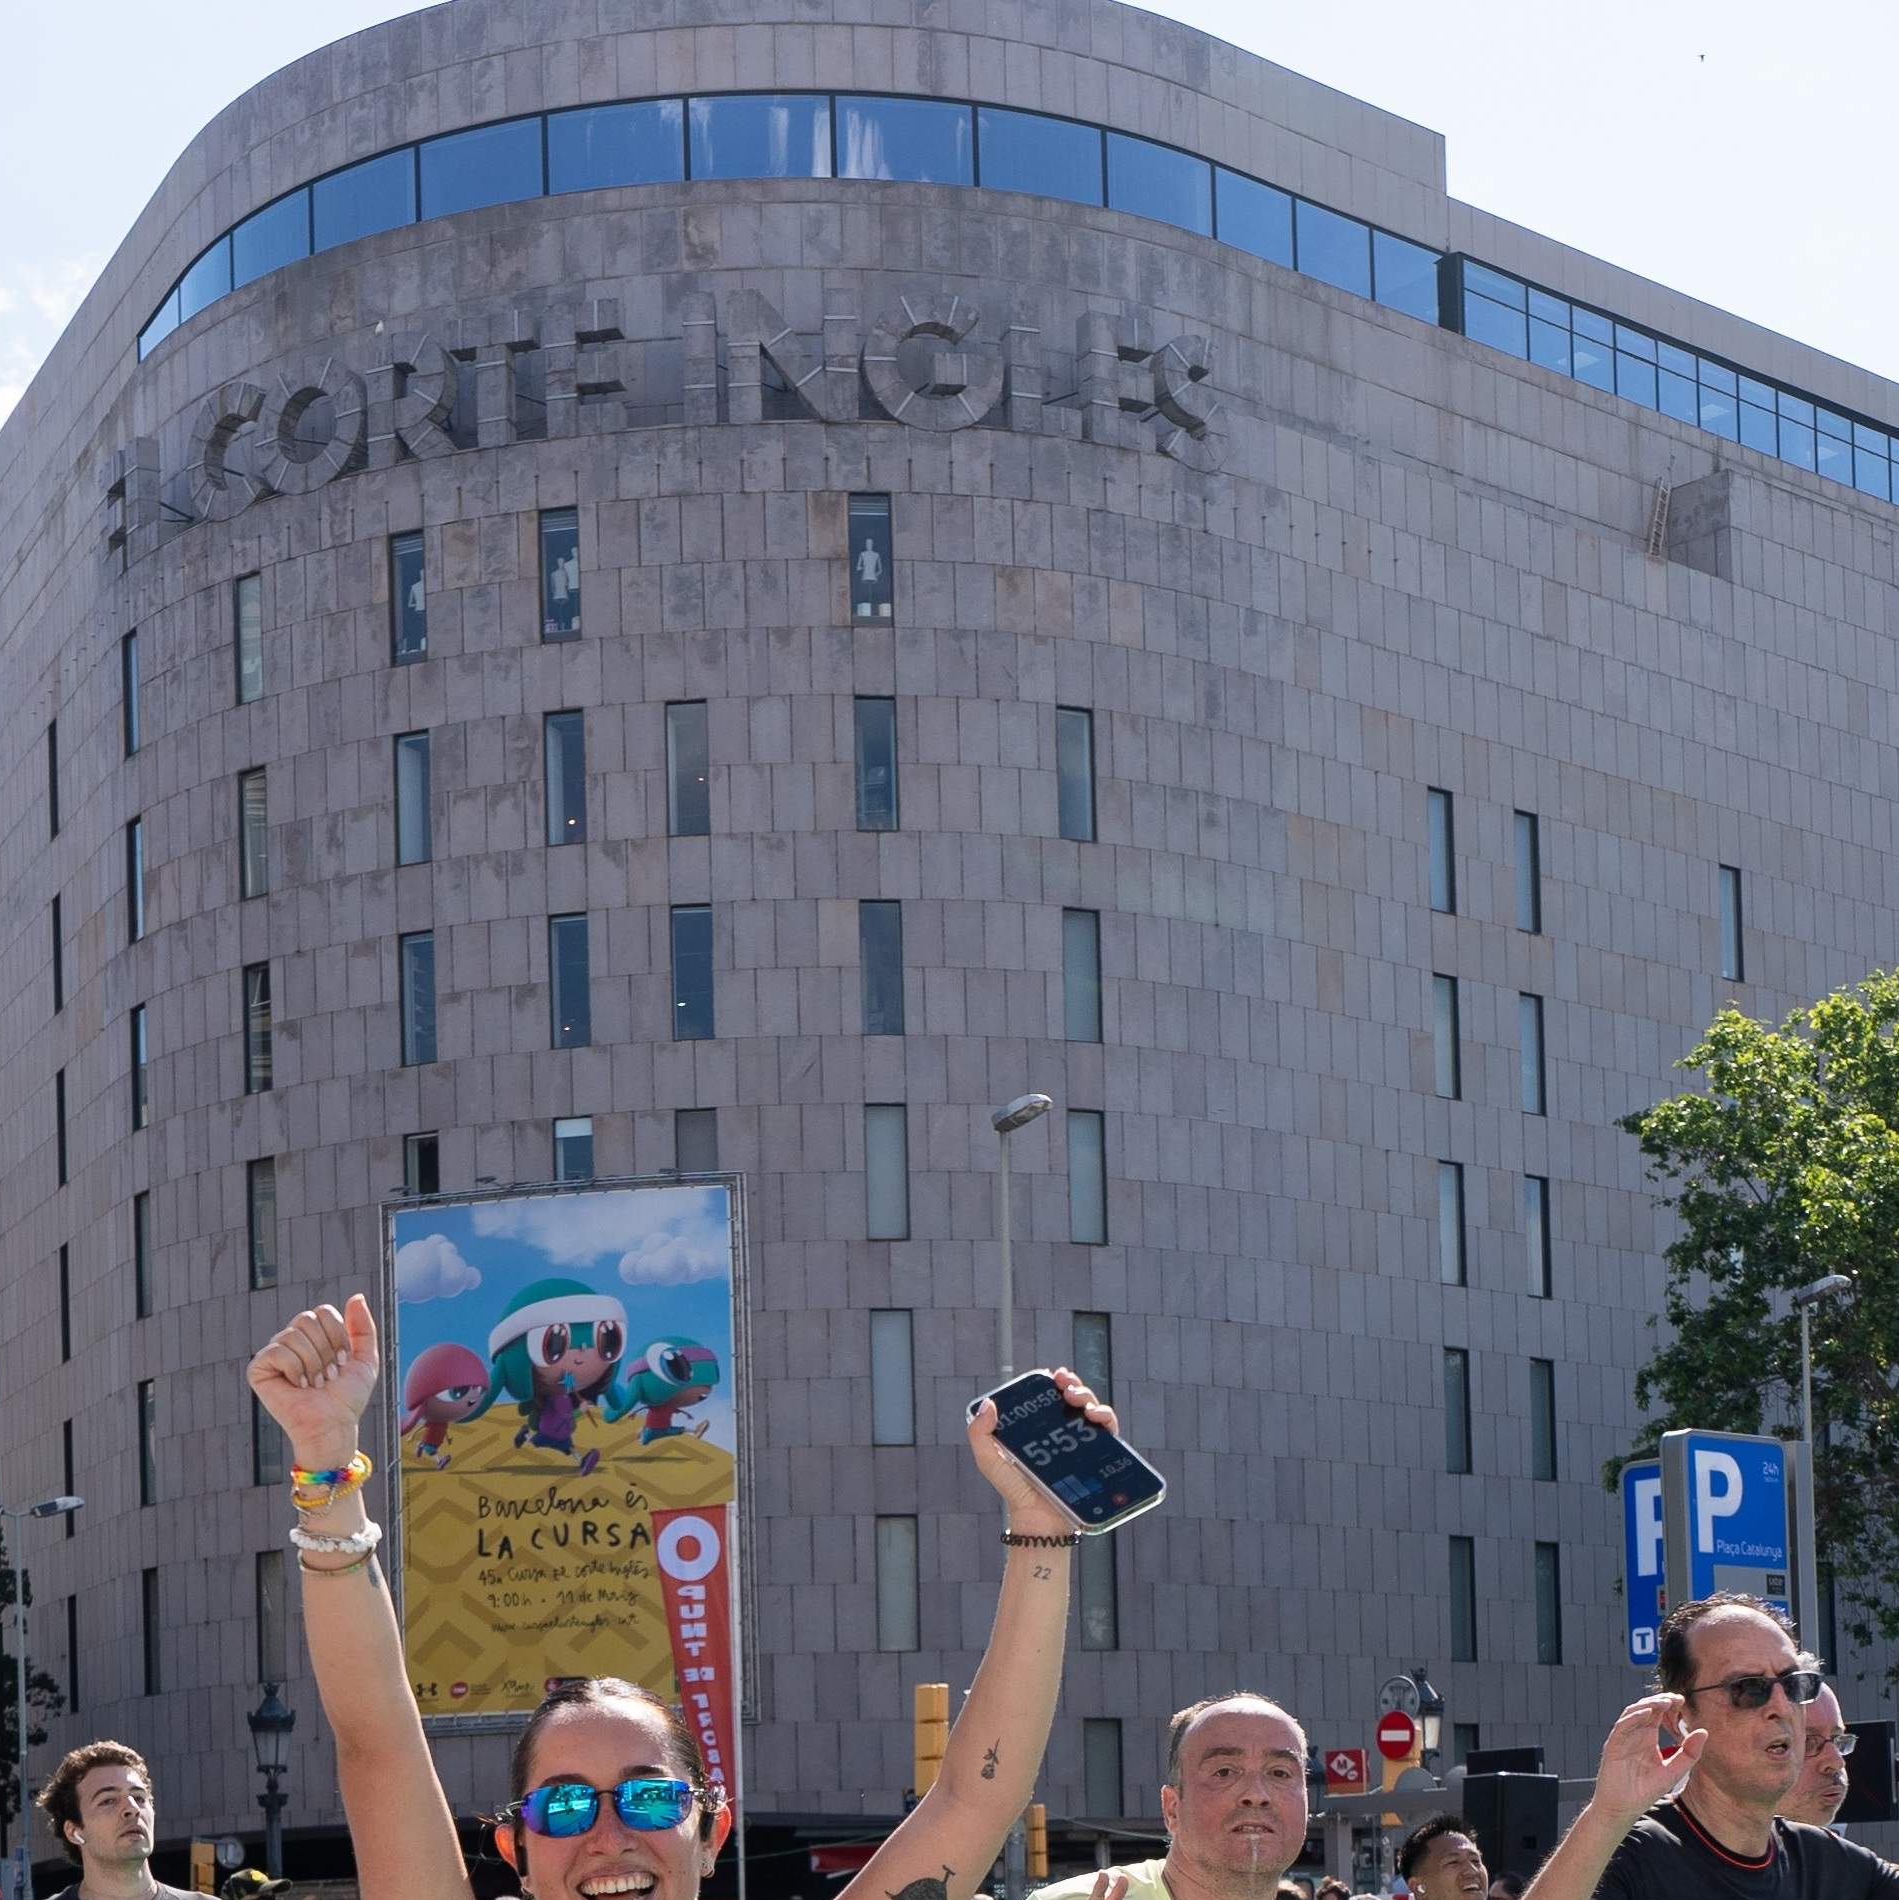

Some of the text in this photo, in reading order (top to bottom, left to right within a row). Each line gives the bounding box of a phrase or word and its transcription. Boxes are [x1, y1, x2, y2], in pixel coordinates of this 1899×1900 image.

[188, 298, 628, 525] CORTE
[682, 287, 1229, 474] INGLES
[1022, 1417, 1098, 1466] 5:53
[478, 1483, 649, 1520] Barcelona és
[1694, 1449, 1744, 1553] P
[477, 1519, 652, 1560] LA CURSA
[1716, 1539, 1783, 1562] Plaça Catalunya
[507, 1567, 548, 1583] Cursa
